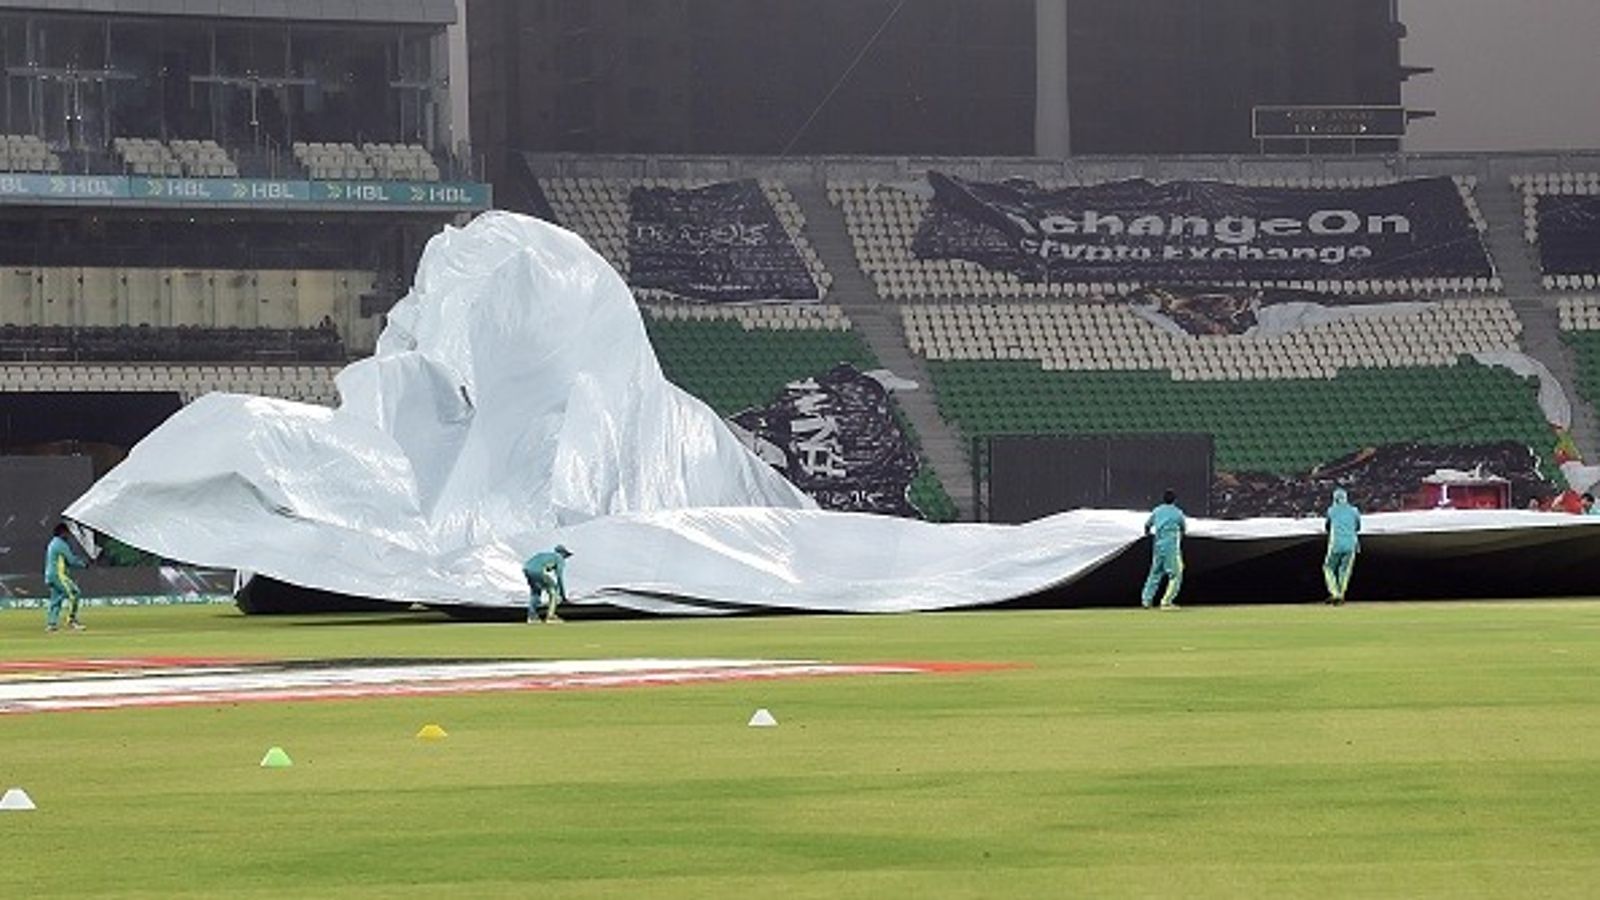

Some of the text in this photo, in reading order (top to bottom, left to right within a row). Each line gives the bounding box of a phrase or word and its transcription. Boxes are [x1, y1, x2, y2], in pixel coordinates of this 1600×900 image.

[0, 177, 472, 203] BL HBL HBL HBL HBL HBL
